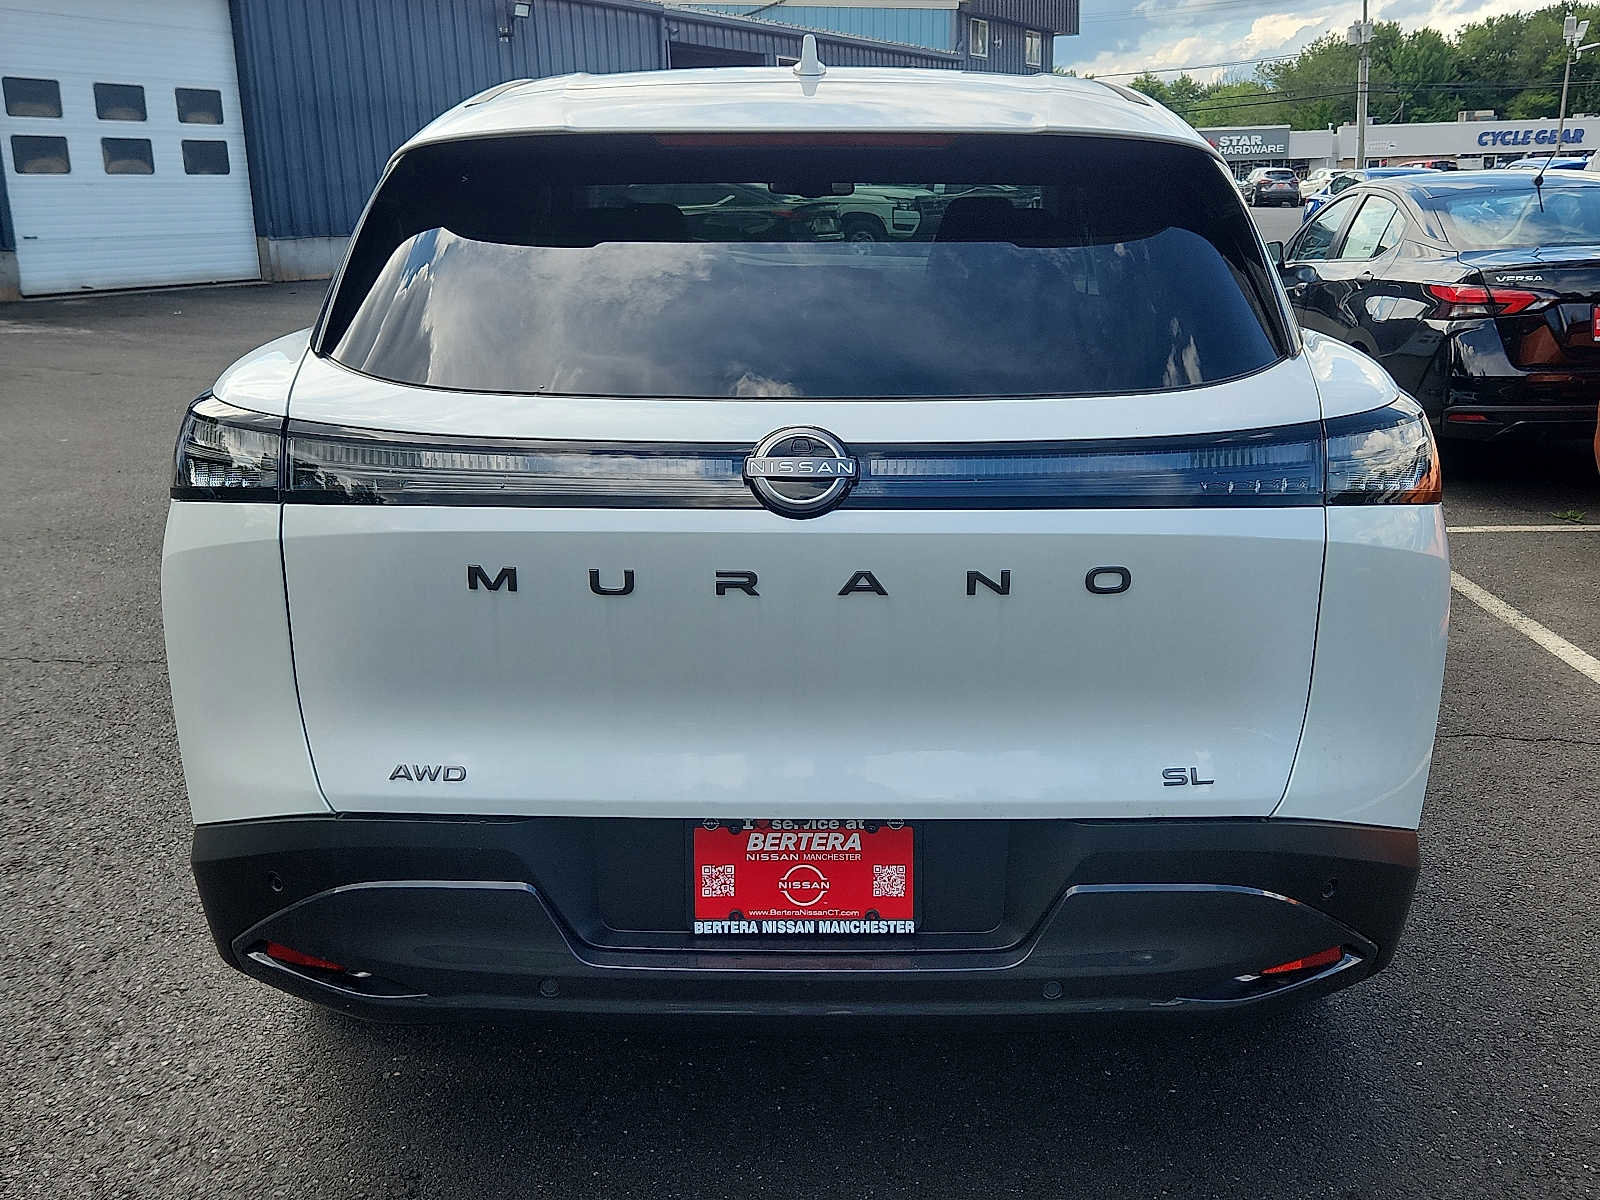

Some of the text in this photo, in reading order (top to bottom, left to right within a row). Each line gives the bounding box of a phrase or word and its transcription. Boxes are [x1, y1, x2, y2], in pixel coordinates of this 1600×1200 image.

[1219, 135, 1262, 147] STAR
[1477, 128, 1585, 146] CYCLE GEAR
[1218, 144, 1284, 155] HARDWARE
[749, 461, 854, 474] NISSAN
[466, 564, 1132, 597] MURANO
[388, 763, 467, 782] AWD
[1162, 767, 1215, 786] SL
[845, 819, 865, 830] at
[746, 832, 862, 851] BERTERA
[746, 853, 861, 861] NISSAN MANCHESTER
[778, 881, 830, 889] NISSAN
[748, 908, 860, 917] www.BerteraNissanCT.com
[694, 921, 915, 934] BERTERA NISSAN MANCHESTER
